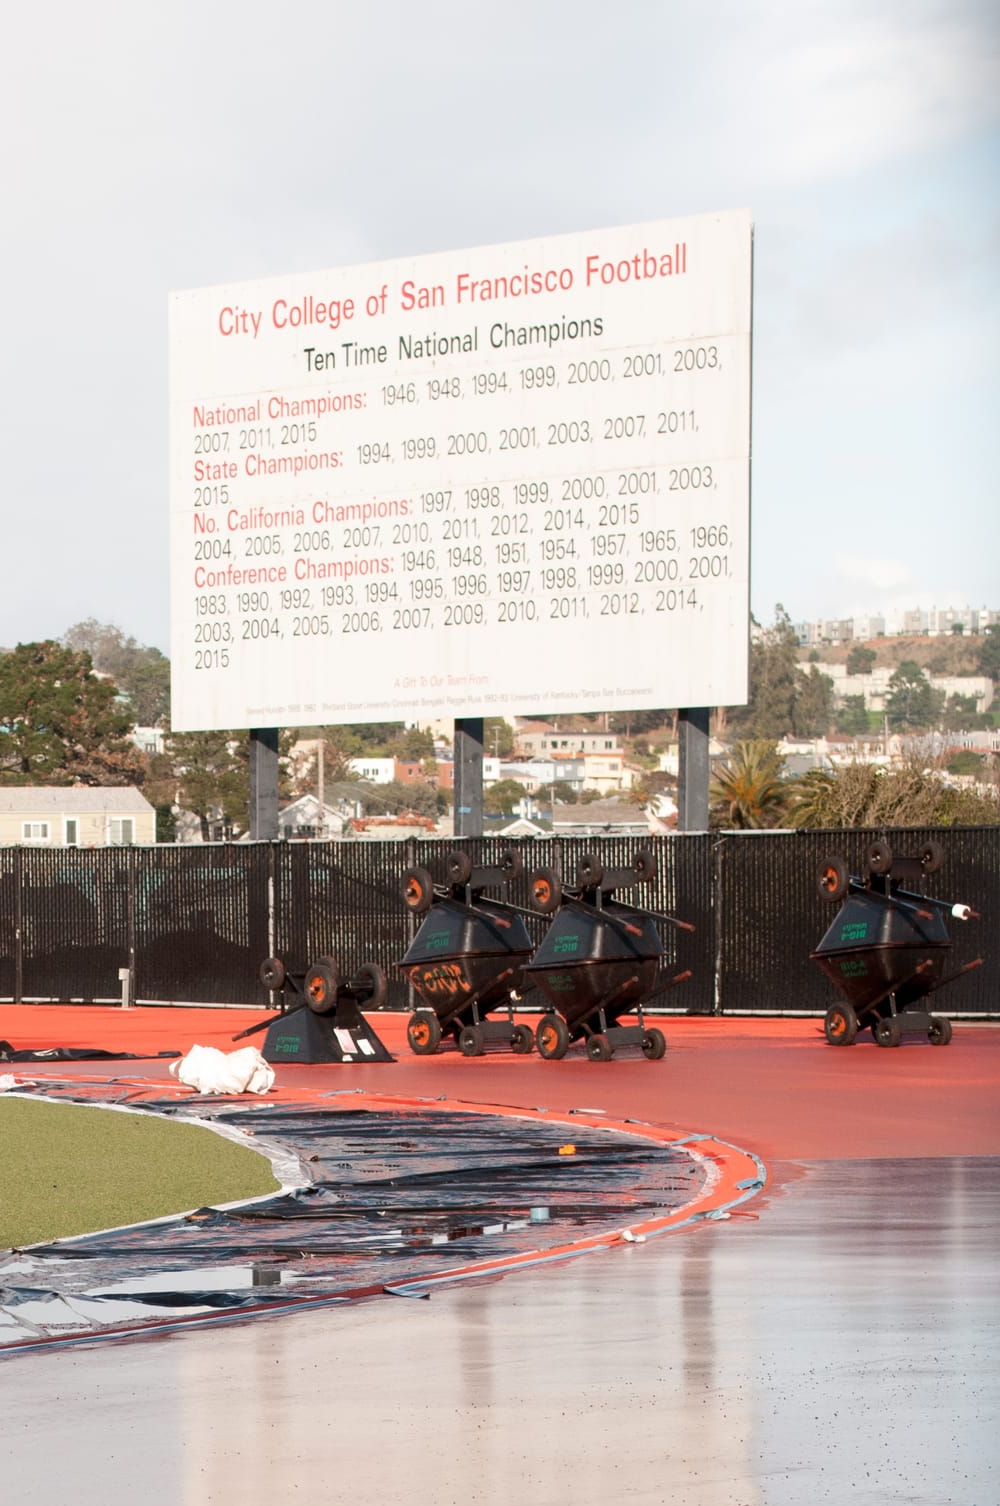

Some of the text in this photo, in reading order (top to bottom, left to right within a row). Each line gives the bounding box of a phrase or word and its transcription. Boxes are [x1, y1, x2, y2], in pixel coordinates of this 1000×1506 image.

[219, 243, 687, 339] City College of San Francisco Football
[304, 315, 603, 372] Ten Time National Champions
[193, 346, 722, 428] National Champions: 1946, 1948, 1994, 1999, 2000, 2001, 2003,
[194, 422, 317, 454] 2007, 2011, 2015
[194, 410, 699, 481] State Champions: 1994, 1999, 2000, 2001, 2003, 2007, 2011,
[194, 466, 717, 534] No. California Champions: 1997, 1998, 1999, 2000, 2001, 2003,
[194, 504, 639, 561] 2004, 2005, 2006, 2007, 2010, 2011, 2012, 2014, 2015
[194, 525, 732, 588] Conference Champions: 1946, 1948, 1951, 1954, 1957, 1965, 1966,
[195, 555, 732, 616] 1983, 1990, 1992, 1993, 1994, 1995, 1996, 1997, 1998, 1999, 2000, 2001,
[194, 589, 704, 644] 2003, 2004, 2005, 2006, 2007, 2009, 2010, 2011, 2012, 2014,
[194, 649, 230, 670] 2015
